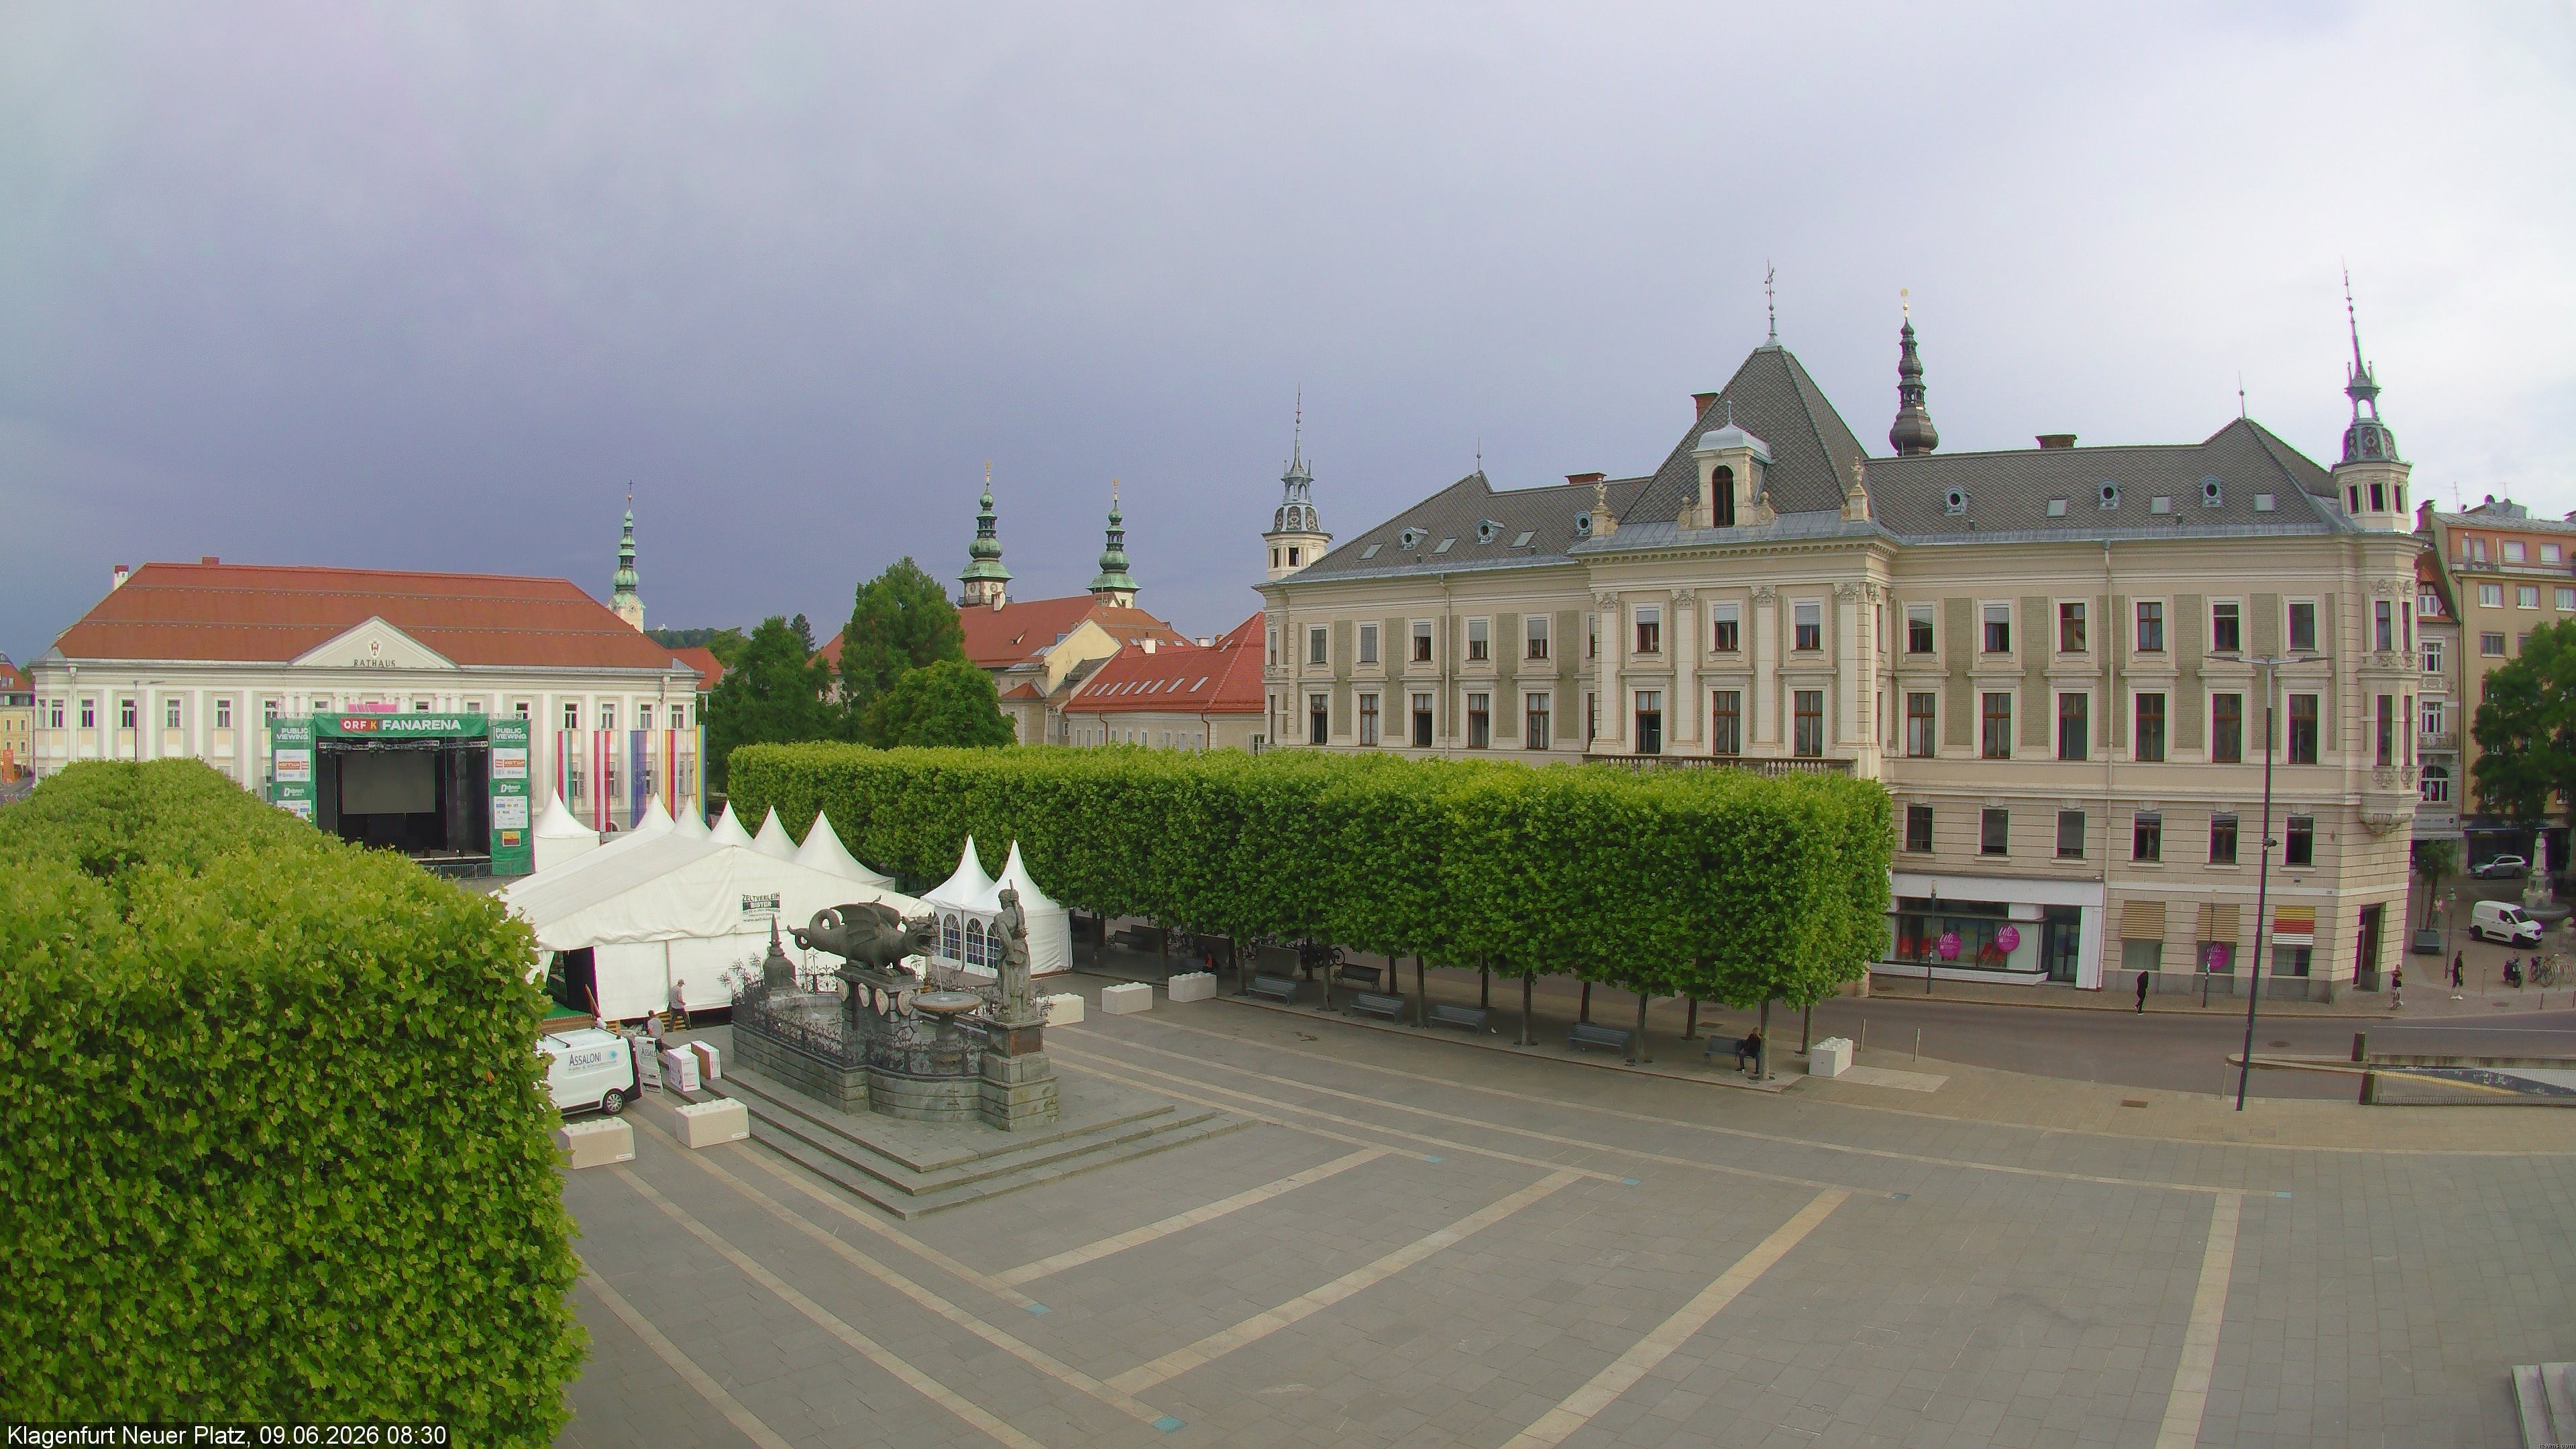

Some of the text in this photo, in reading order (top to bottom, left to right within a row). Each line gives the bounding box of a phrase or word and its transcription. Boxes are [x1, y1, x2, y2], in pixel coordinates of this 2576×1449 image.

[354, 659, 396, 667] RATHAUS
[343, 719, 462, 731] ORF K FANARENA
[568, 1052, 602, 1067] ASSALONI
